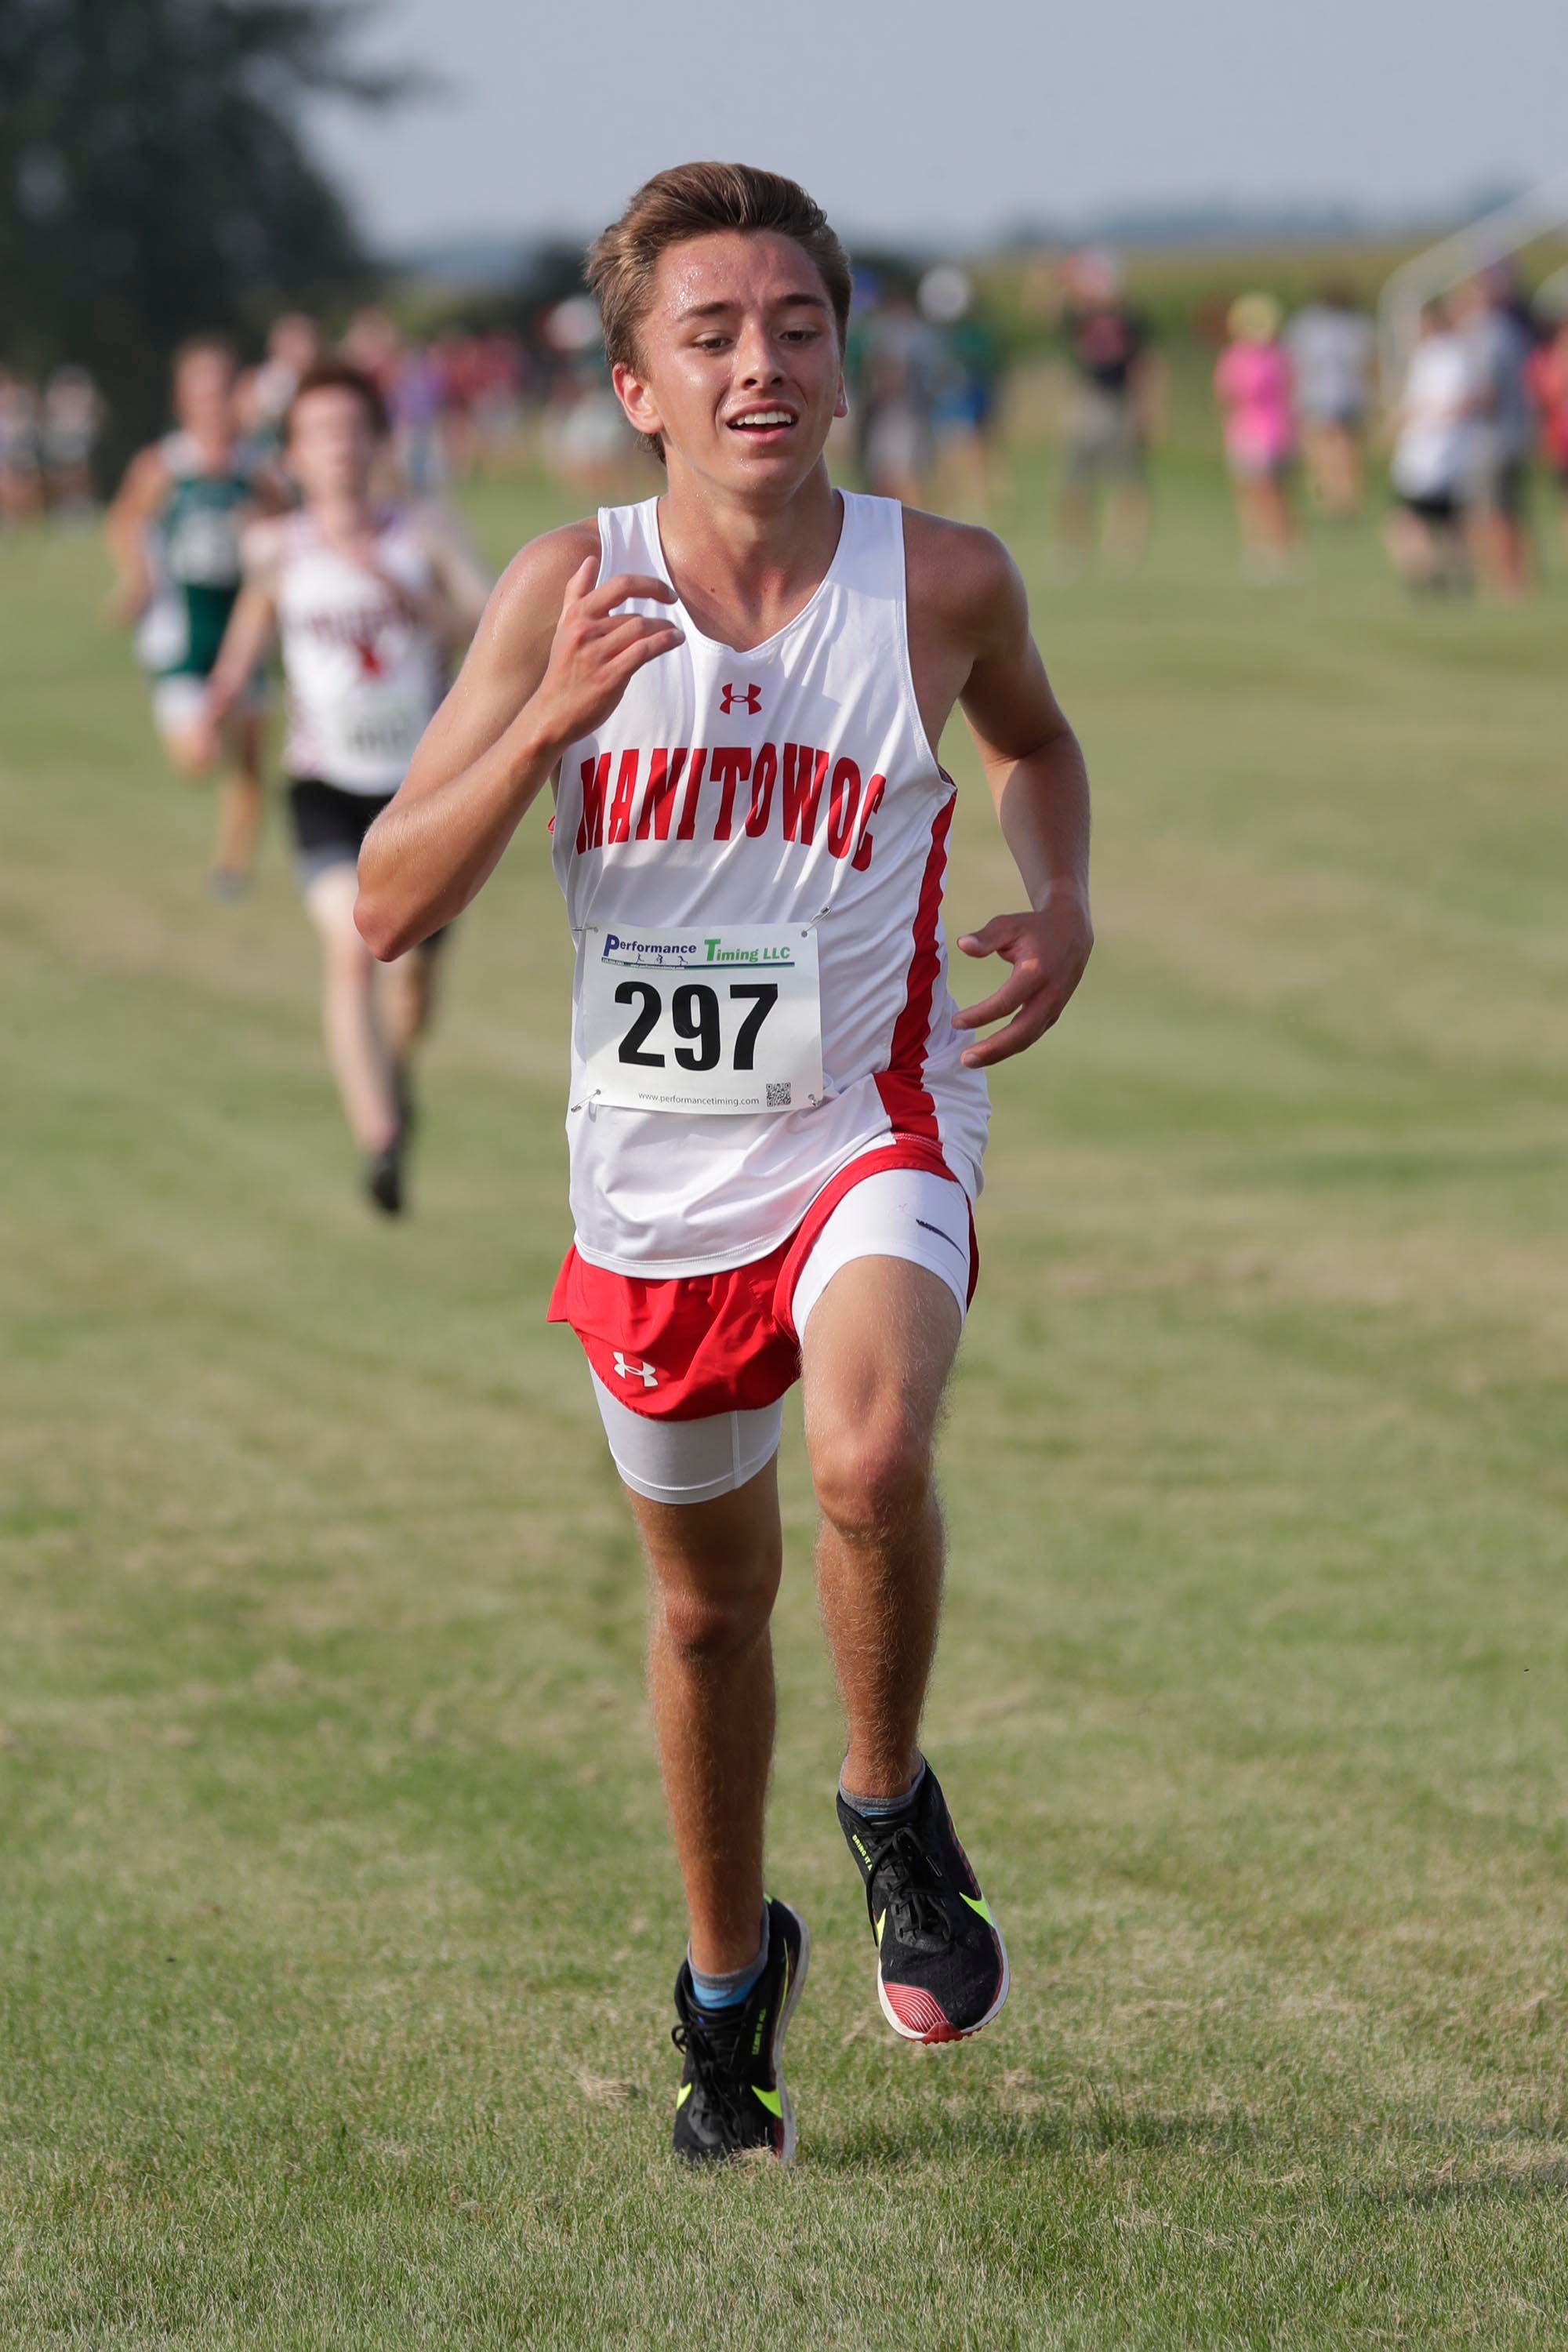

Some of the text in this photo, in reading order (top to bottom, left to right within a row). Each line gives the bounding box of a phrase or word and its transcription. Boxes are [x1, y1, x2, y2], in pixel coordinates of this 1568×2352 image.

[575, 742, 886, 872] MANITOWOC
[603, 934, 790, 962] Performance Timing LLC
[615, 981, 779, 1071] 297
[638, 1092, 760, 1106] www.performancetiming.com
